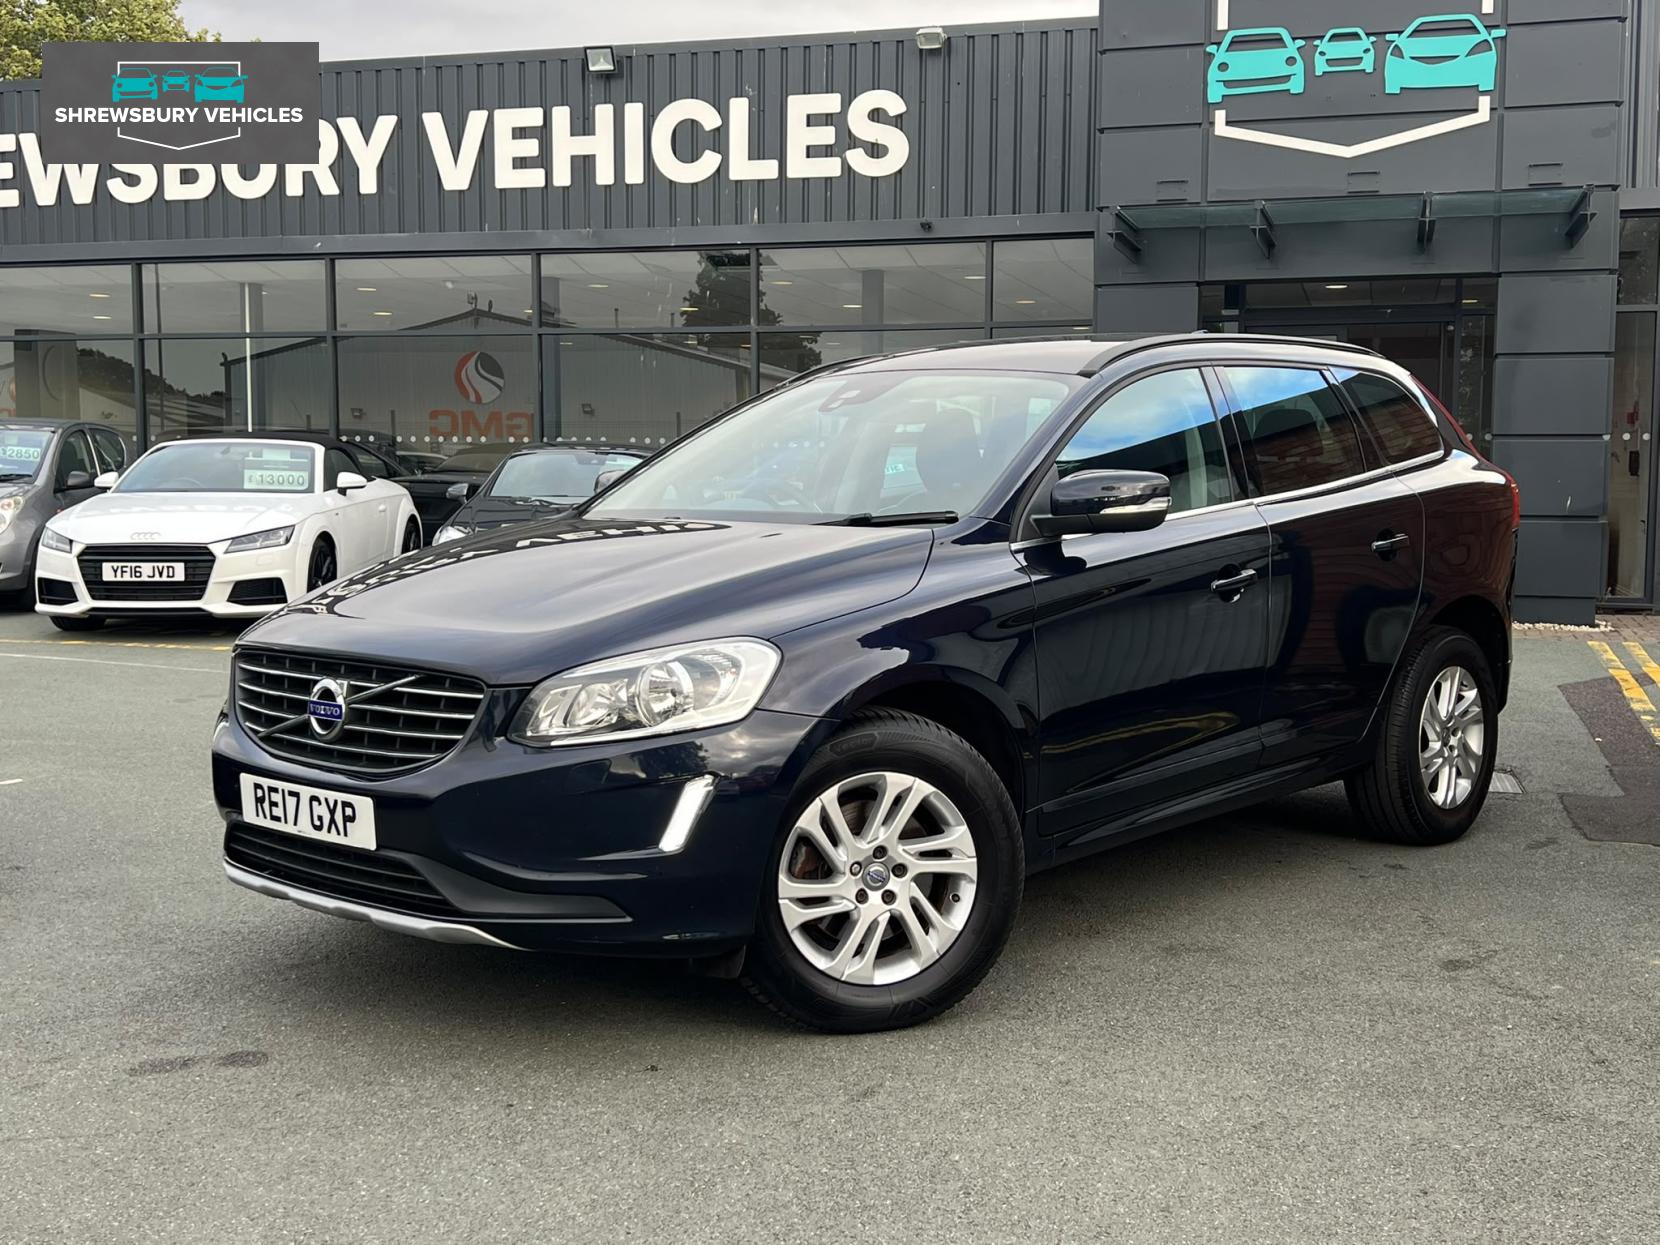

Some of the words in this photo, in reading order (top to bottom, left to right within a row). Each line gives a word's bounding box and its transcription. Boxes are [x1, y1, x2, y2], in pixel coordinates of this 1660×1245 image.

[421, 89, 910, 191] VEHICLES
[111, 565, 143, 578] YF16
[147, 565, 175, 578] JVD
[310, 703, 340, 716] VOLVO
[253, 782, 301, 827] RE17
[309, 795, 356, 838] GXP
